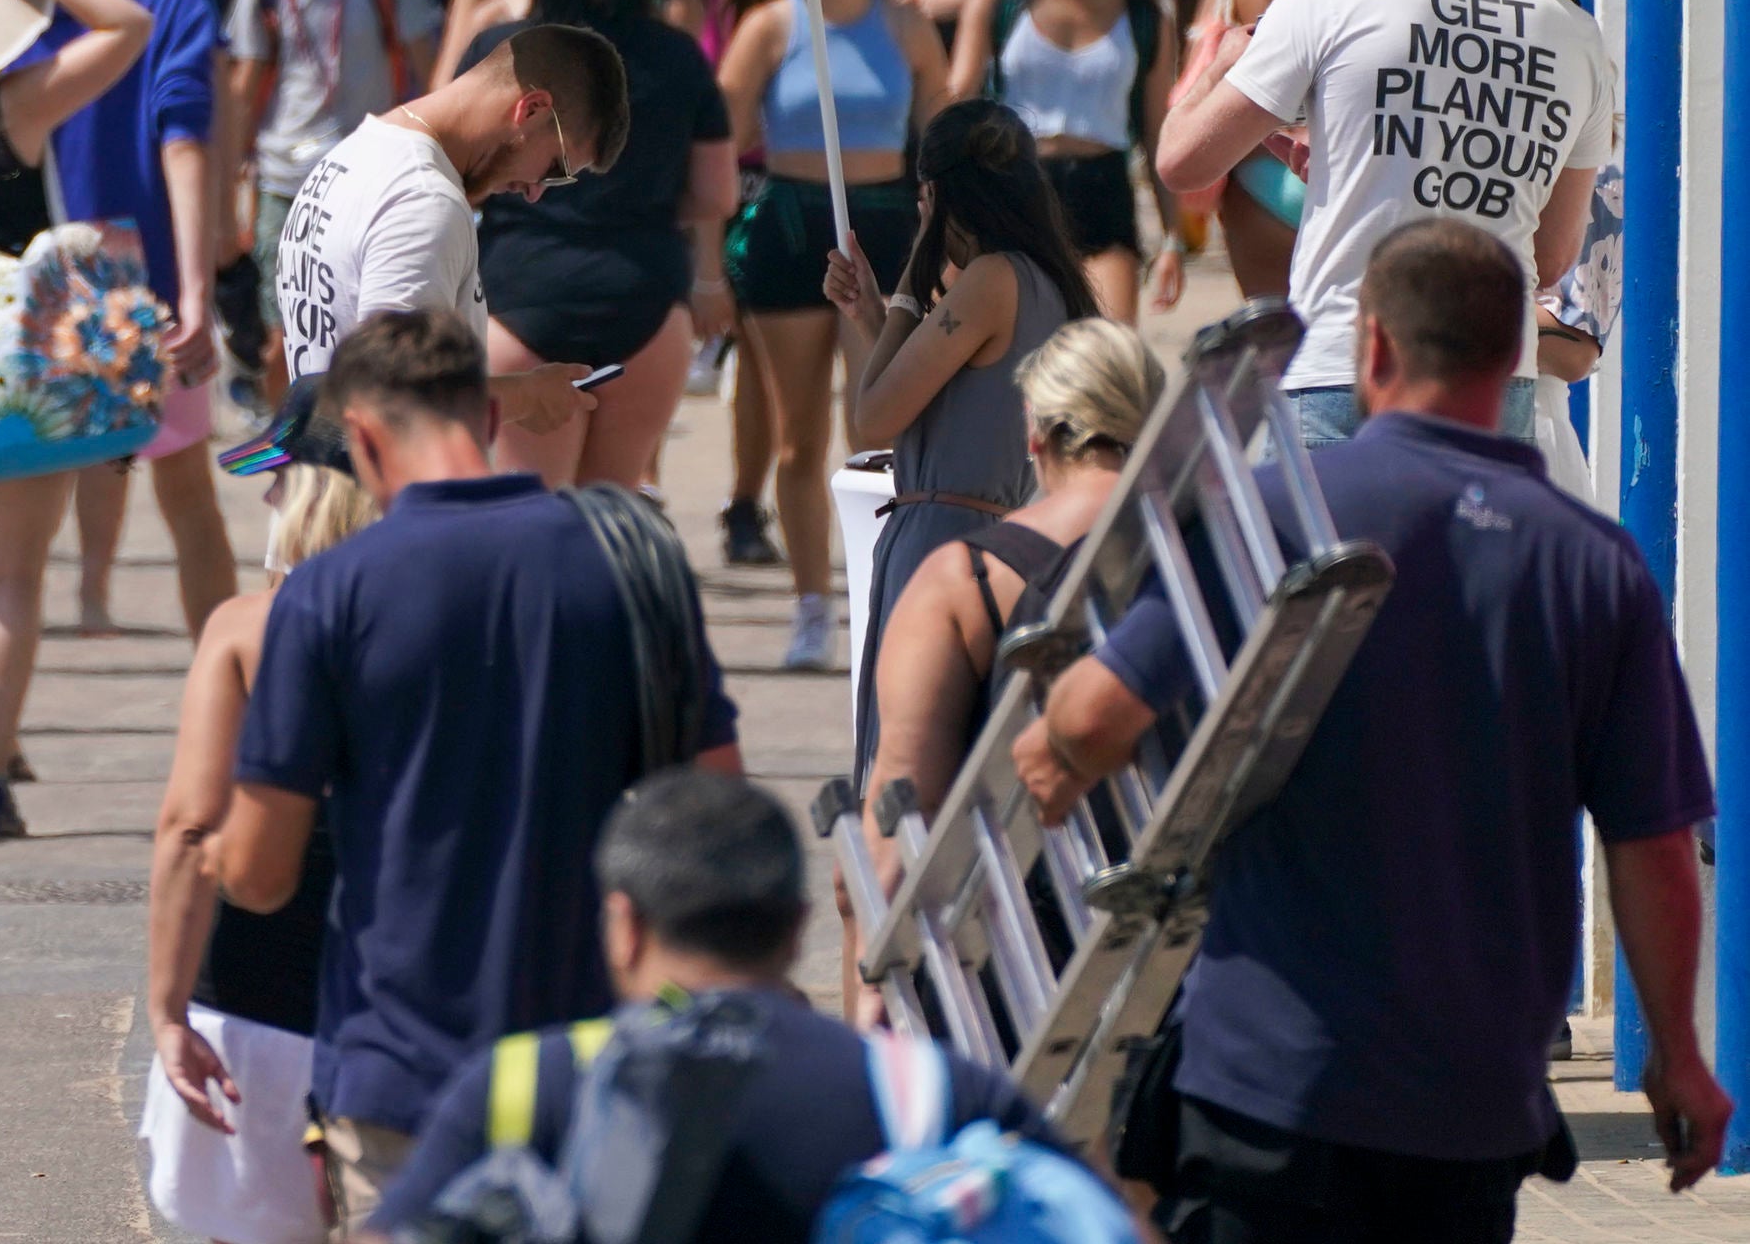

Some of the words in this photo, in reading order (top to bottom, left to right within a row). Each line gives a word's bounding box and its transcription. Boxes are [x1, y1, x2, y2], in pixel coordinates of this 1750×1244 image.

[1408, 23, 1556, 92] MORE
[1376, 68, 1572, 143] PLANTS
[302, 159, 349, 201] GET
[1373, 114, 1424, 159] IN
[1438, 120, 1559, 186] YOUR
[1413, 166, 1515, 219] GOB
[283, 201, 332, 254] MORE
